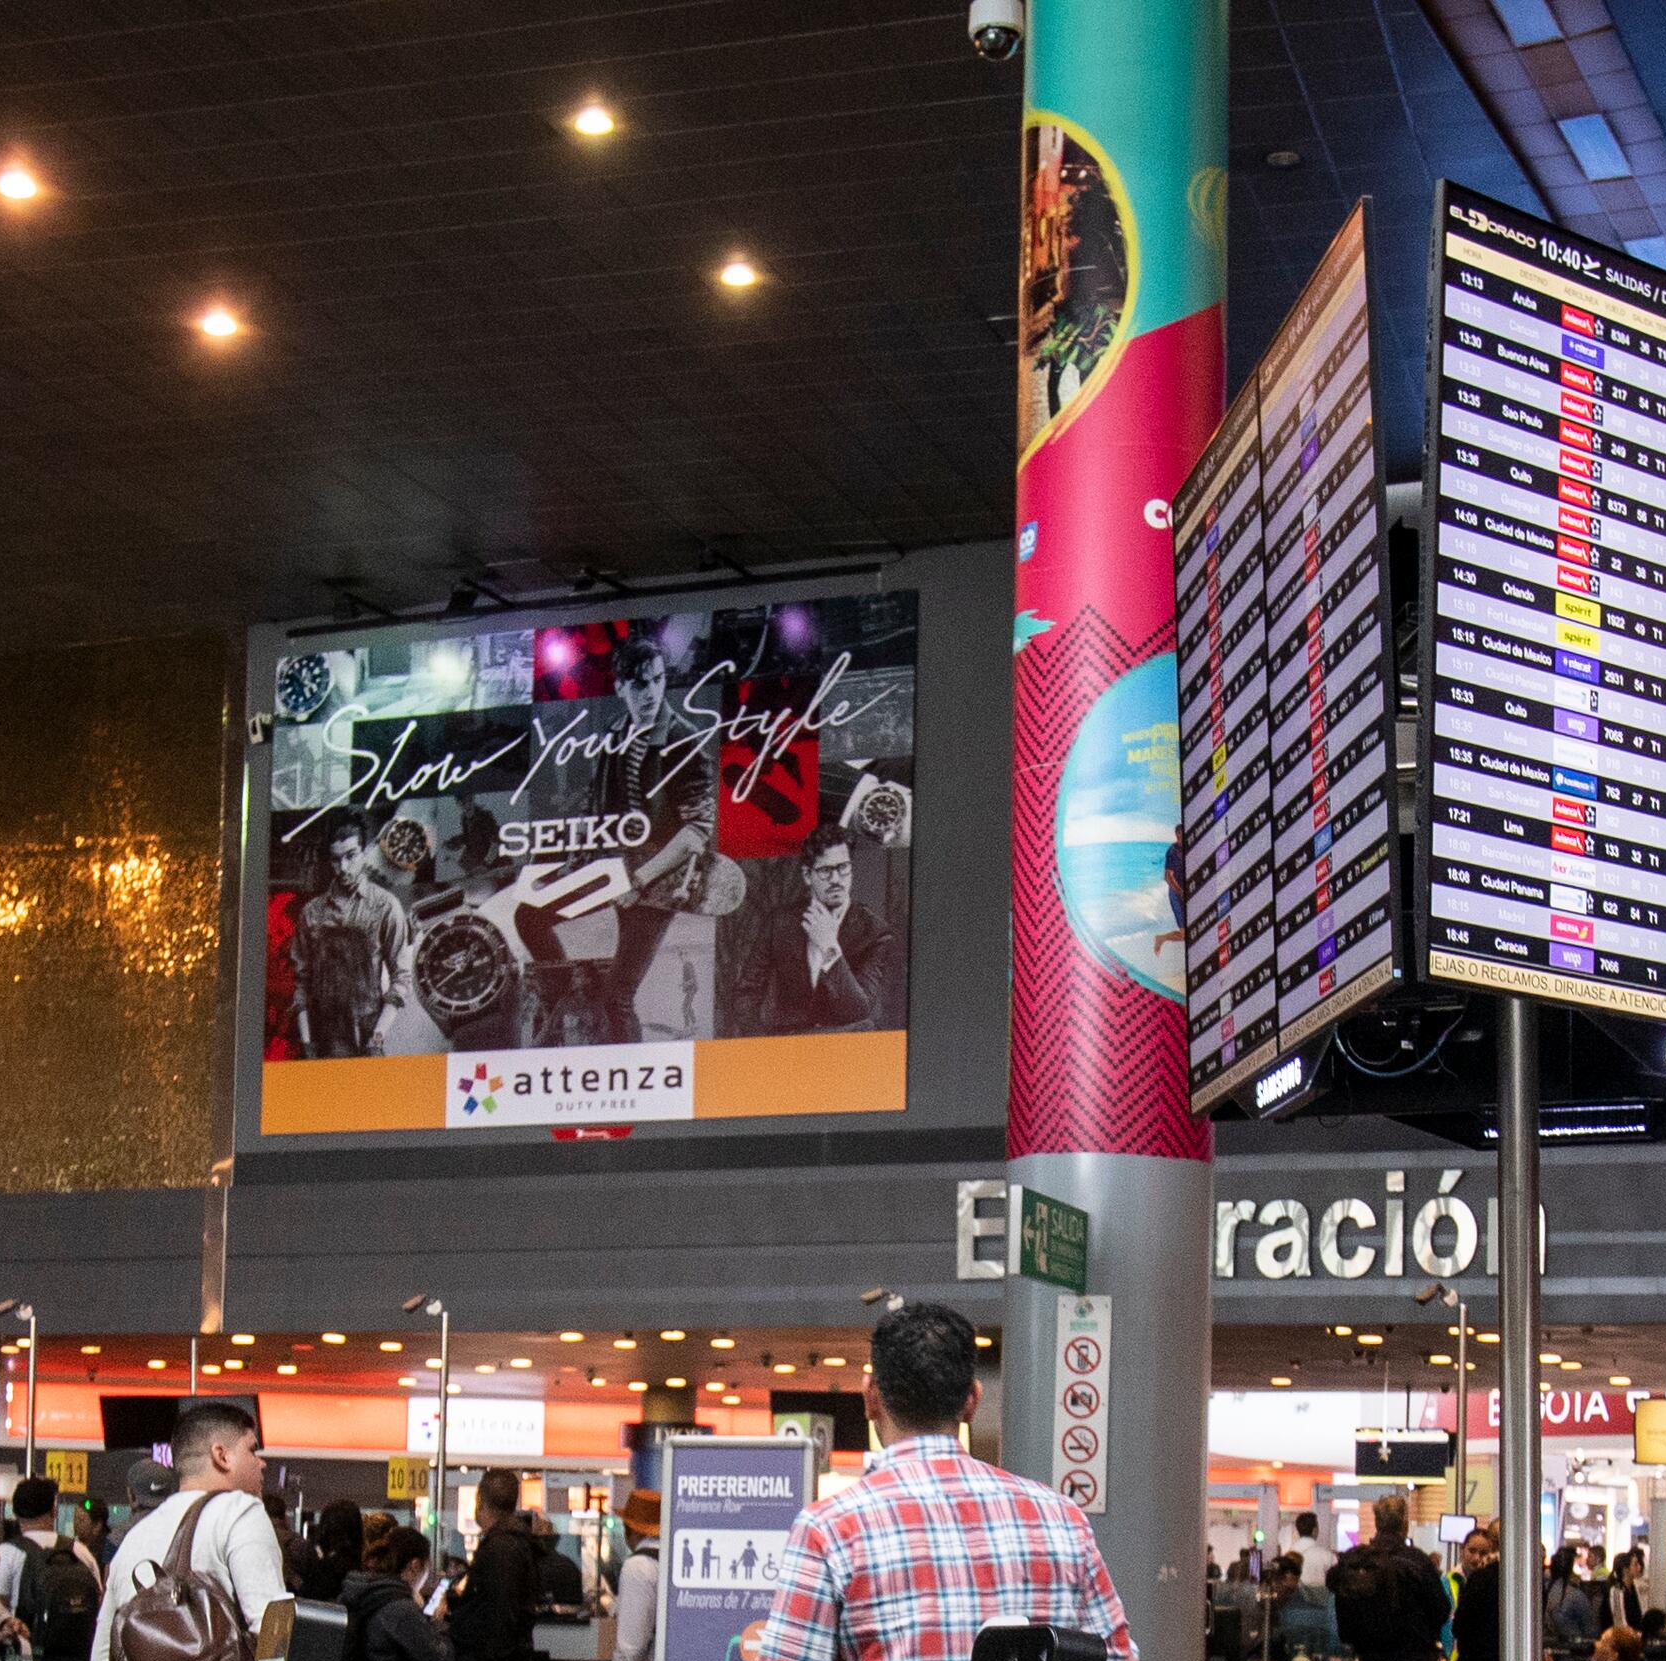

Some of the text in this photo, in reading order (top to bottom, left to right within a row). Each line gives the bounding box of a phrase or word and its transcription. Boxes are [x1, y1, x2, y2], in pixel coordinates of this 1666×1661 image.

[1449, 204, 1470, 224] EL
[1467, 208, 1536, 248] DORADO
[1539, 237, 1580, 270] 10:40
[1605, 267, 1651, 297] SALIDAS
[1460, 271, 1483, 290] 13:13
[1497, 343, 1528, 365] Buenos
[1528, 355, 1550, 373] Aires
[1611, 385, 1627, 401] 217
[1501, 404, 1543, 429] Sao Paulo
[1509, 466, 1532, 484] Quito
[1484, 516, 1554, 549] Ciudad de Mexico
[1502, 581, 1535, 602] Orlando
[1564, 603, 1591, 617] spirit
[1451, 627, 1552, 666] 15:15 Ciudad de Mexico
[1450, 687, 1527, 718] 15:33 Quito
[281, 651, 897, 842] Show Your Style
[1449, 746, 1550, 782] 15:35 Ciudad de Mexico
[498, 810, 651, 859] SEIKO
[1447, 807, 1470, 823] 17:21
[1503, 819, 1524, 836] Lima
[1604, 842, 1619, 858] 133
[1480, 874, 1618, 915] Ciudad Panama 622
[1445, 927, 1528, 955] 18:45 Caracas
[1467, 961, 1478, 977] O
[1480, 964, 1550, 992] RECLAMOS,
[1608, 989, 1617, 1003] A
[514, 1064, 683, 1095] attenza
[1255, 1056, 1303, 1109] SAMSUNG
[555, 1099, 636, 1112] DUTY FREE
[390, 1468, 404, 1490] 10
[410, 1468, 428, 1490] 10
[677, 1475, 794, 1498] PREFERENCIAL
[676, 1590, 722, 1608] Menores
[725, 1592, 739, 1609] de
[741, 1593, 749, 1609] 7
